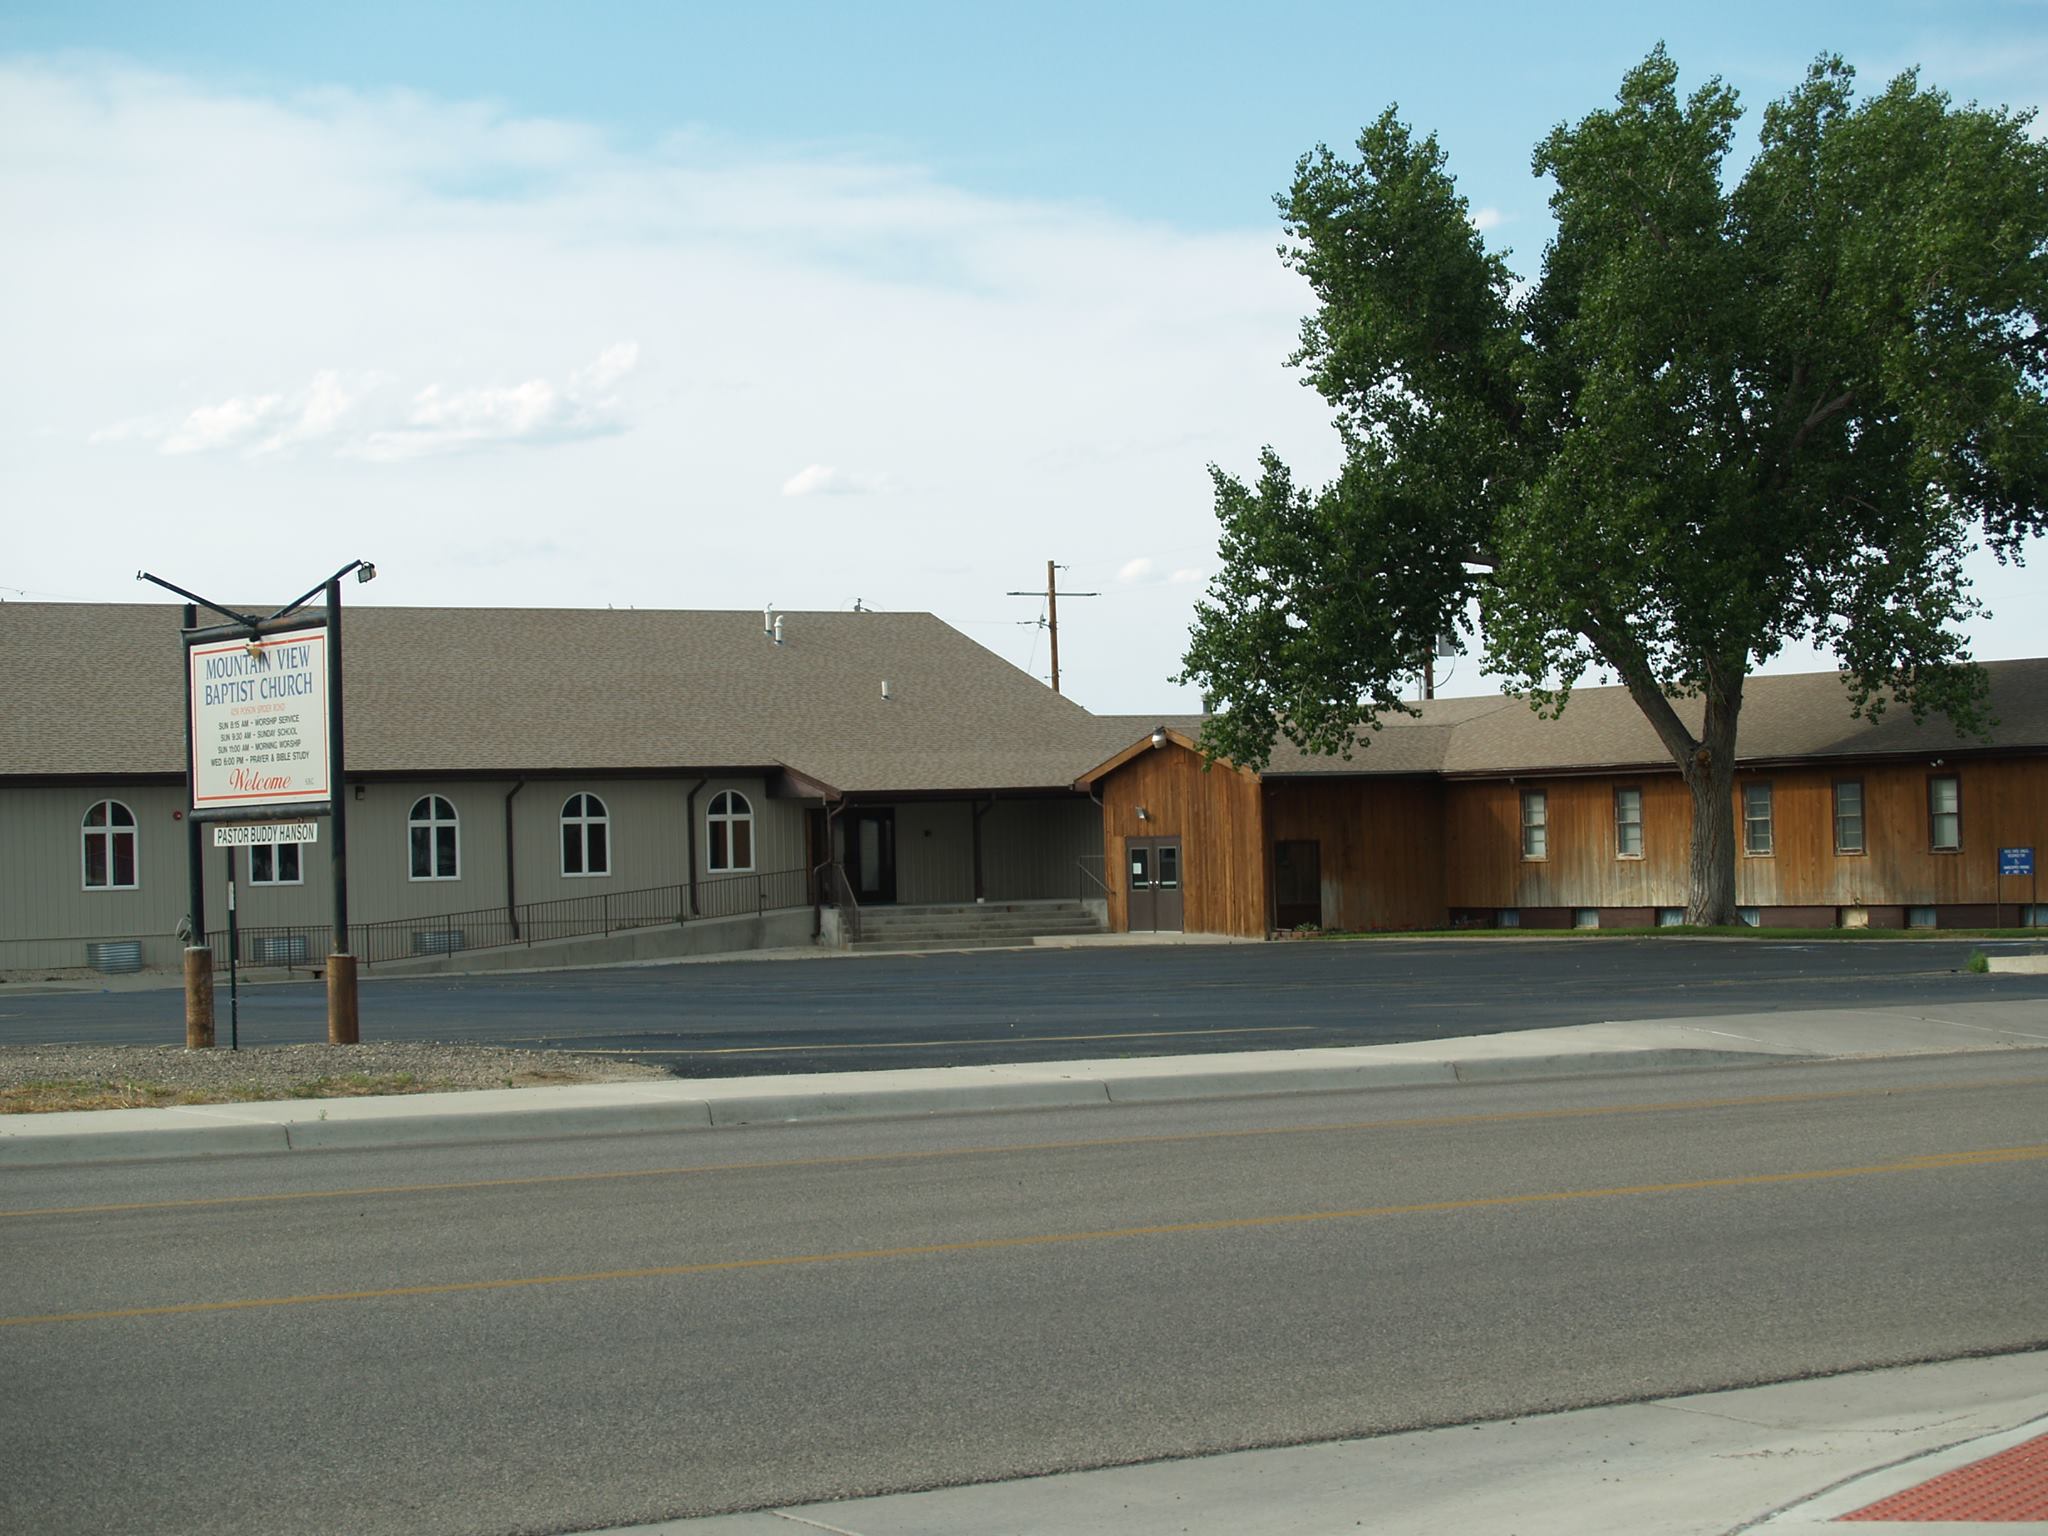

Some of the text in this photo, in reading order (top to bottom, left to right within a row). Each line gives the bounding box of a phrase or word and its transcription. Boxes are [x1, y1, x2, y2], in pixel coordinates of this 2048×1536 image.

[206, 645, 310, 680] MOUNTAIN VIEW
[205, 672, 312, 705] BAPTIST CHURCH
[219, 722, 229, 730] SUN
[255, 718, 277, 727] WORSHIP
[279, 714, 299, 724] SERVICE
[221, 734, 231, 742] SUN
[244, 731, 252, 739] AM
[257, 730, 276, 739] SUNDAY
[277, 727, 298, 736] SCHOOL
[218, 746, 228, 754] SUN
[255, 741, 278, 750] MORNING
[279, 739, 301, 749] WORSHIP
[211, 758, 222, 767] WED
[236, 756, 244, 764] PM
[250, 755, 270, 763] PRAYER
[277, 752, 291, 761] BIBLE
[293, 751, 309, 760] STUDY
[229, 768, 291, 791] Welcome
[217, 824, 314, 844] PASTOR BUDDY HANSON
